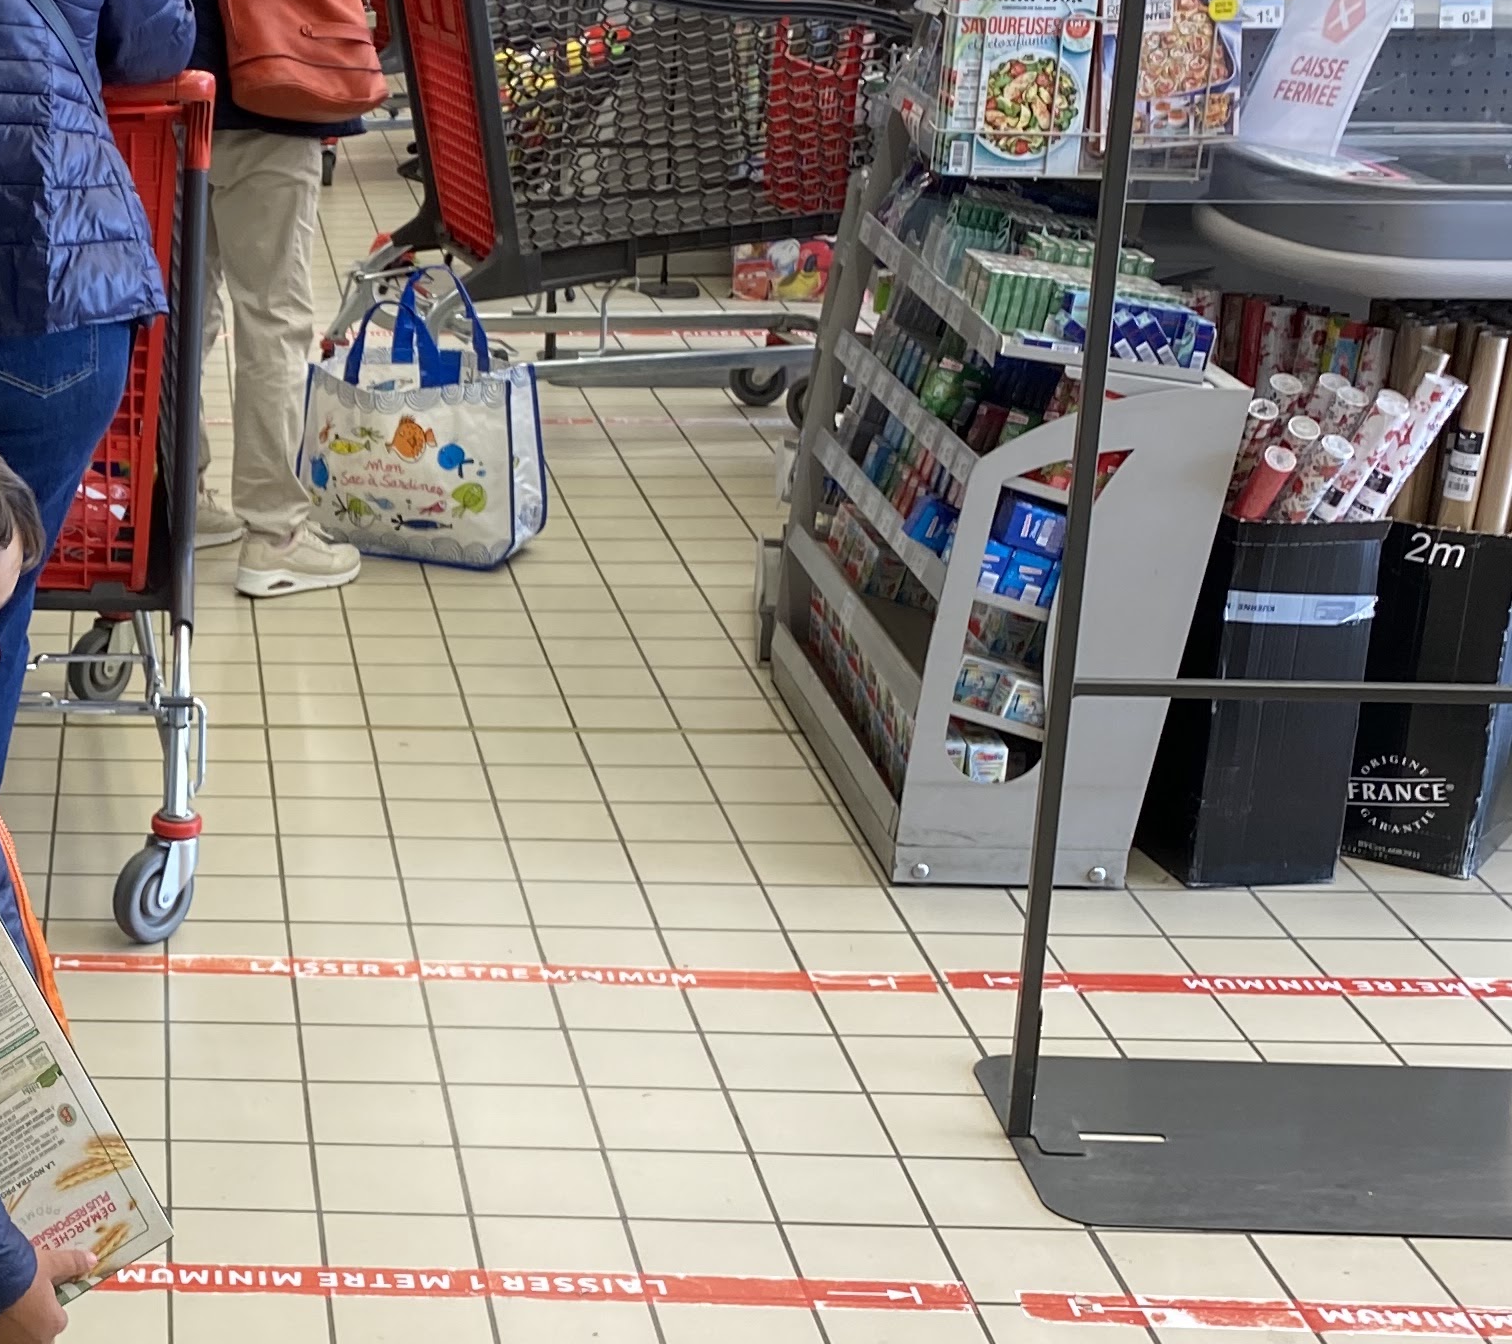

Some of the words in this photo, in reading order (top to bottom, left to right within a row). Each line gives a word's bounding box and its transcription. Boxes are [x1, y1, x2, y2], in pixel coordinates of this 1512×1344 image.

[1291, 56, 1349, 81] CAISSE
[1274, 76, 1341, 107] FERMÉE
[340, 468, 366, 488] Sac
[381, 473, 445, 497] Sardines
[1404, 530, 1467, 569] 2m
[1360, 753, 1430, 778] ORIGINE
[1347, 782, 1449, 804] FRANCE
[1360, 807, 1436, 837] GARANTIE
[250, 960, 383, 977] LAISSER
[422, 963, 529, 981] METRE
[540, 968, 698, 985] MINIMUM
[1182, 978, 1344, 993] MINIMUM
[1352, 979, 1469, 996] METRE
[43, 1159, 56, 1170] LA
[14, 1165, 45, 1189] NOSTRA
[84, 1190, 111, 1213] PLUS
[27, 1204, 88, 1249] RESPONSAB
[50, 1201, 117, 1249] DÉMARCHE
[115, 1266, 303, 1290] MINIMUM
[319, 1270, 451, 1292] METRE
[469, 1275, 486, 1292] 1
[500, 1276, 670, 1296] LAISSER
